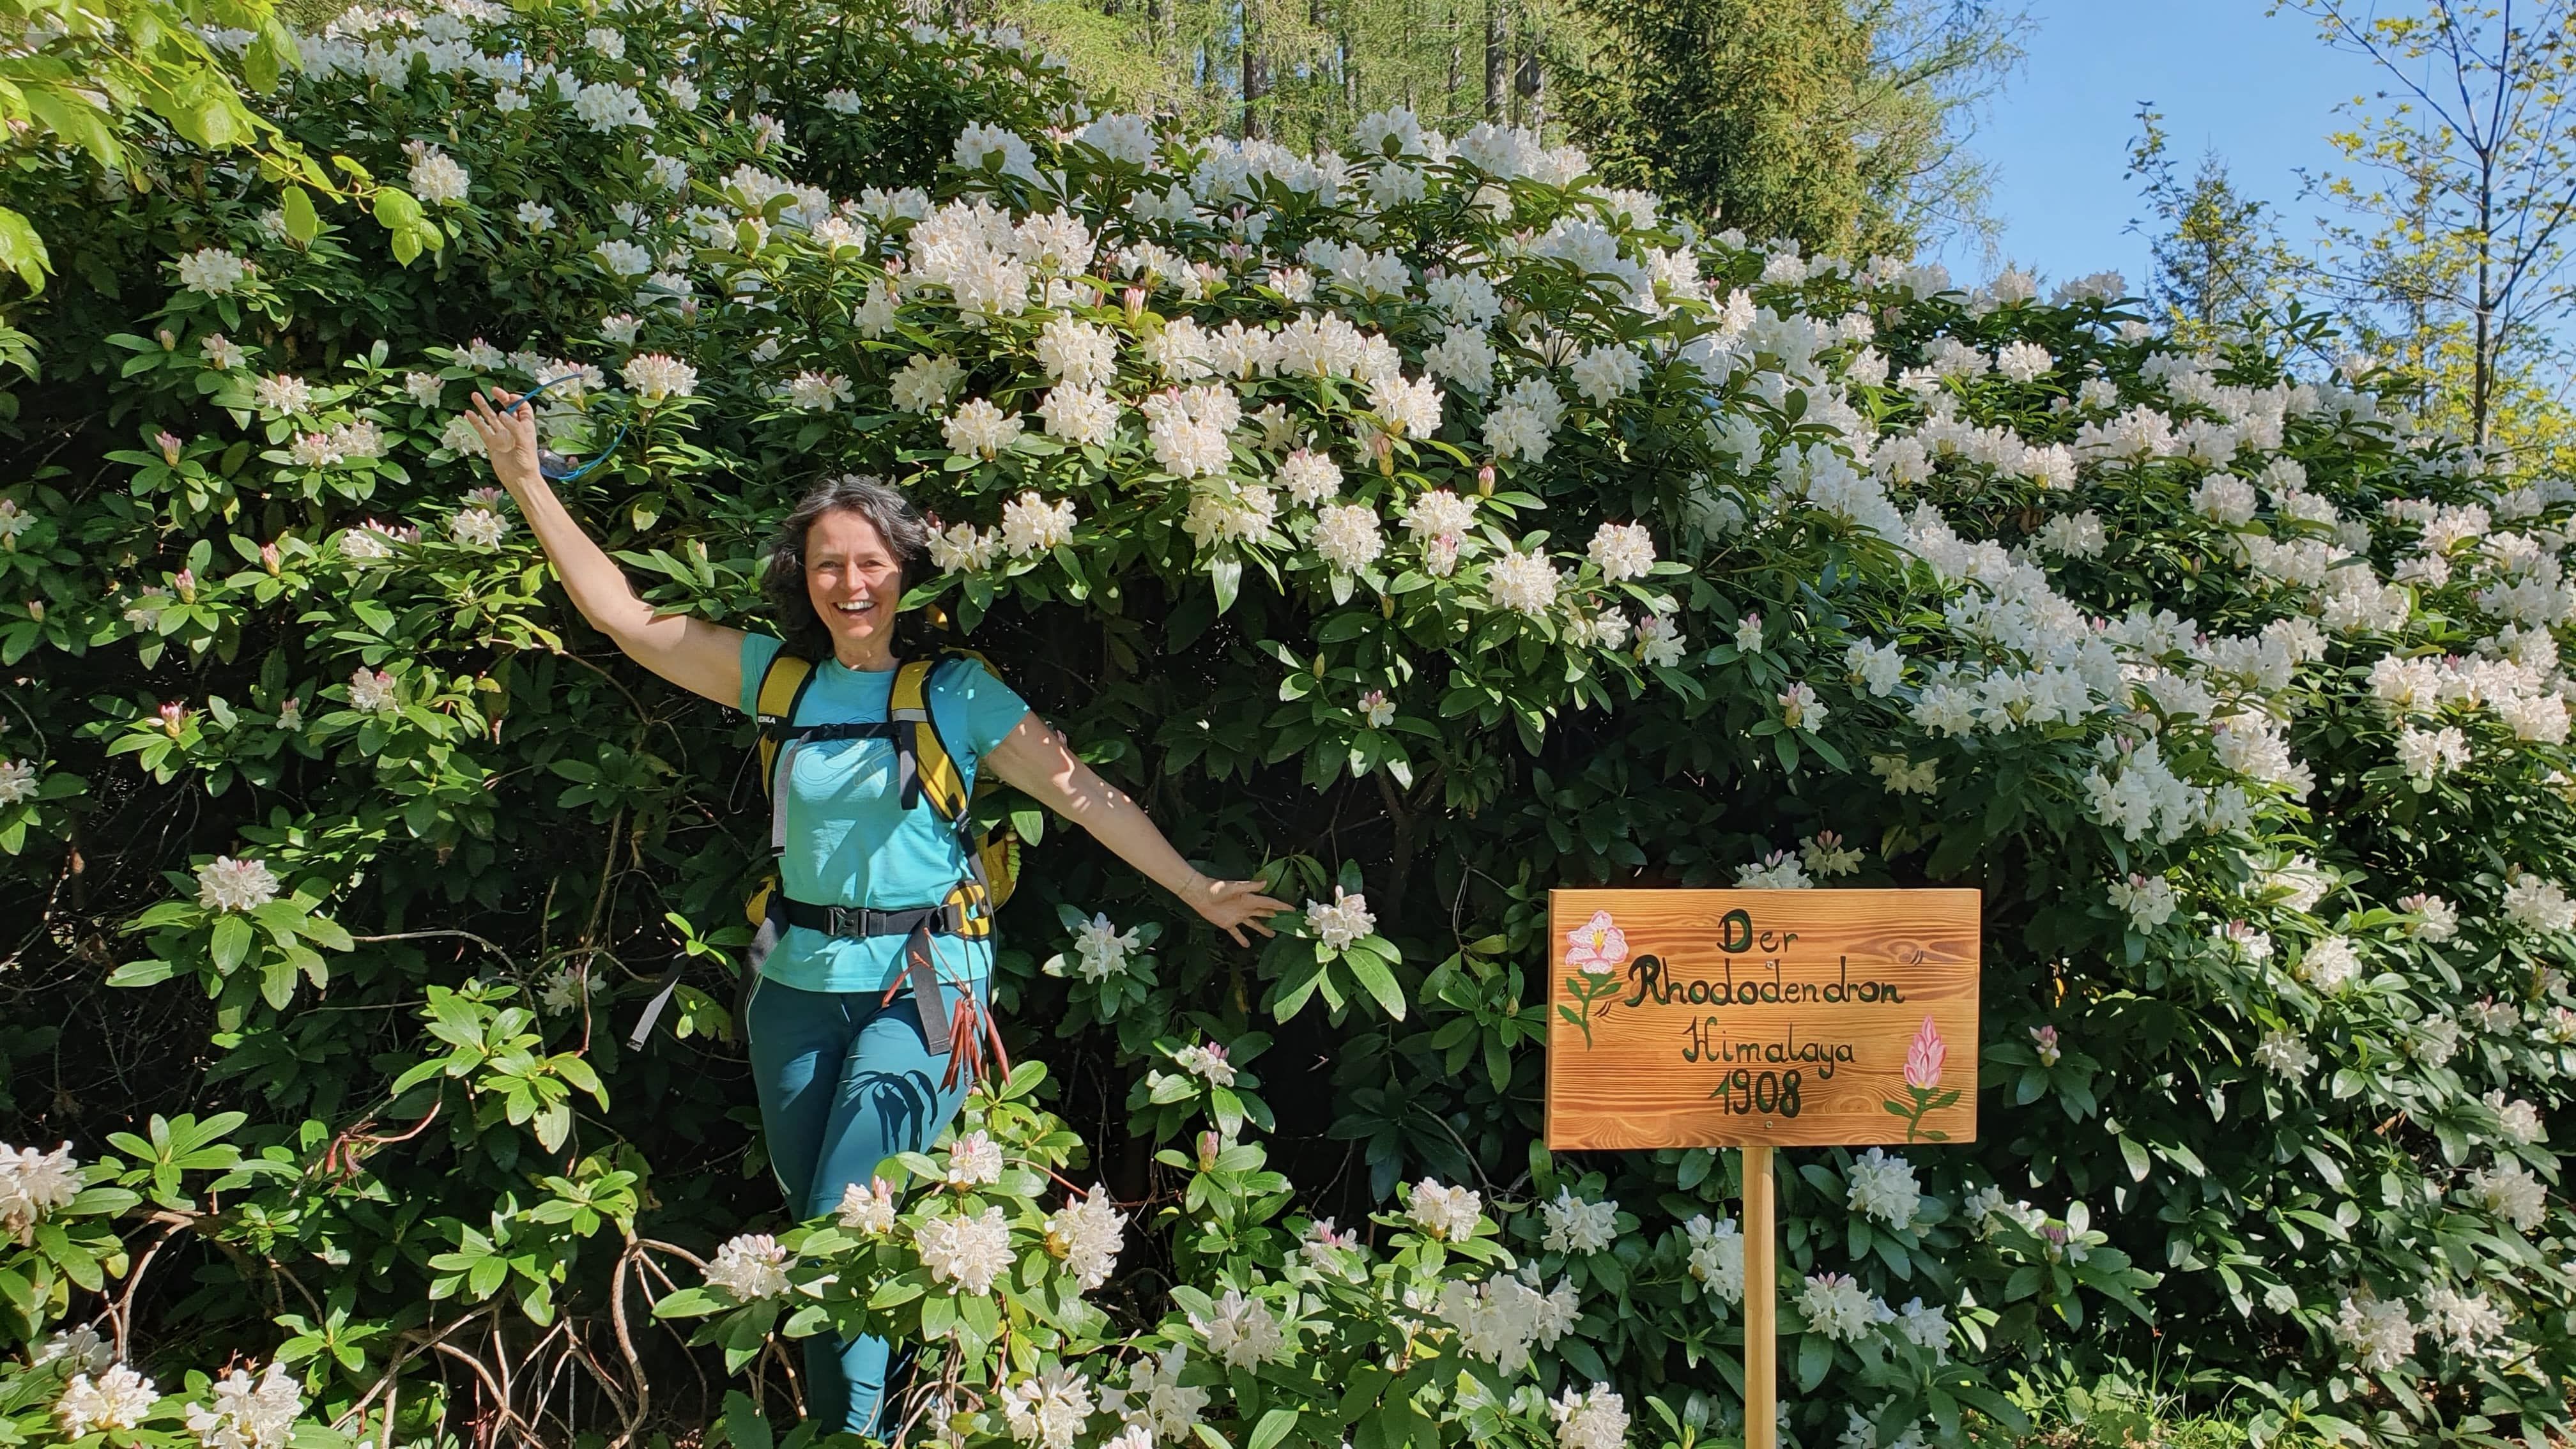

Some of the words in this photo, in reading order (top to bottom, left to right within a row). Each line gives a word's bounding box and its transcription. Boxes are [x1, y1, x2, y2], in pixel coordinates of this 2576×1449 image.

[1717, 908, 1798, 953] Der
[1624, 954, 1905, 1008] Rhododendron
[1682, 1016, 1855, 1078] Himalaya
[1708, 1069, 1802, 1117] 1908
